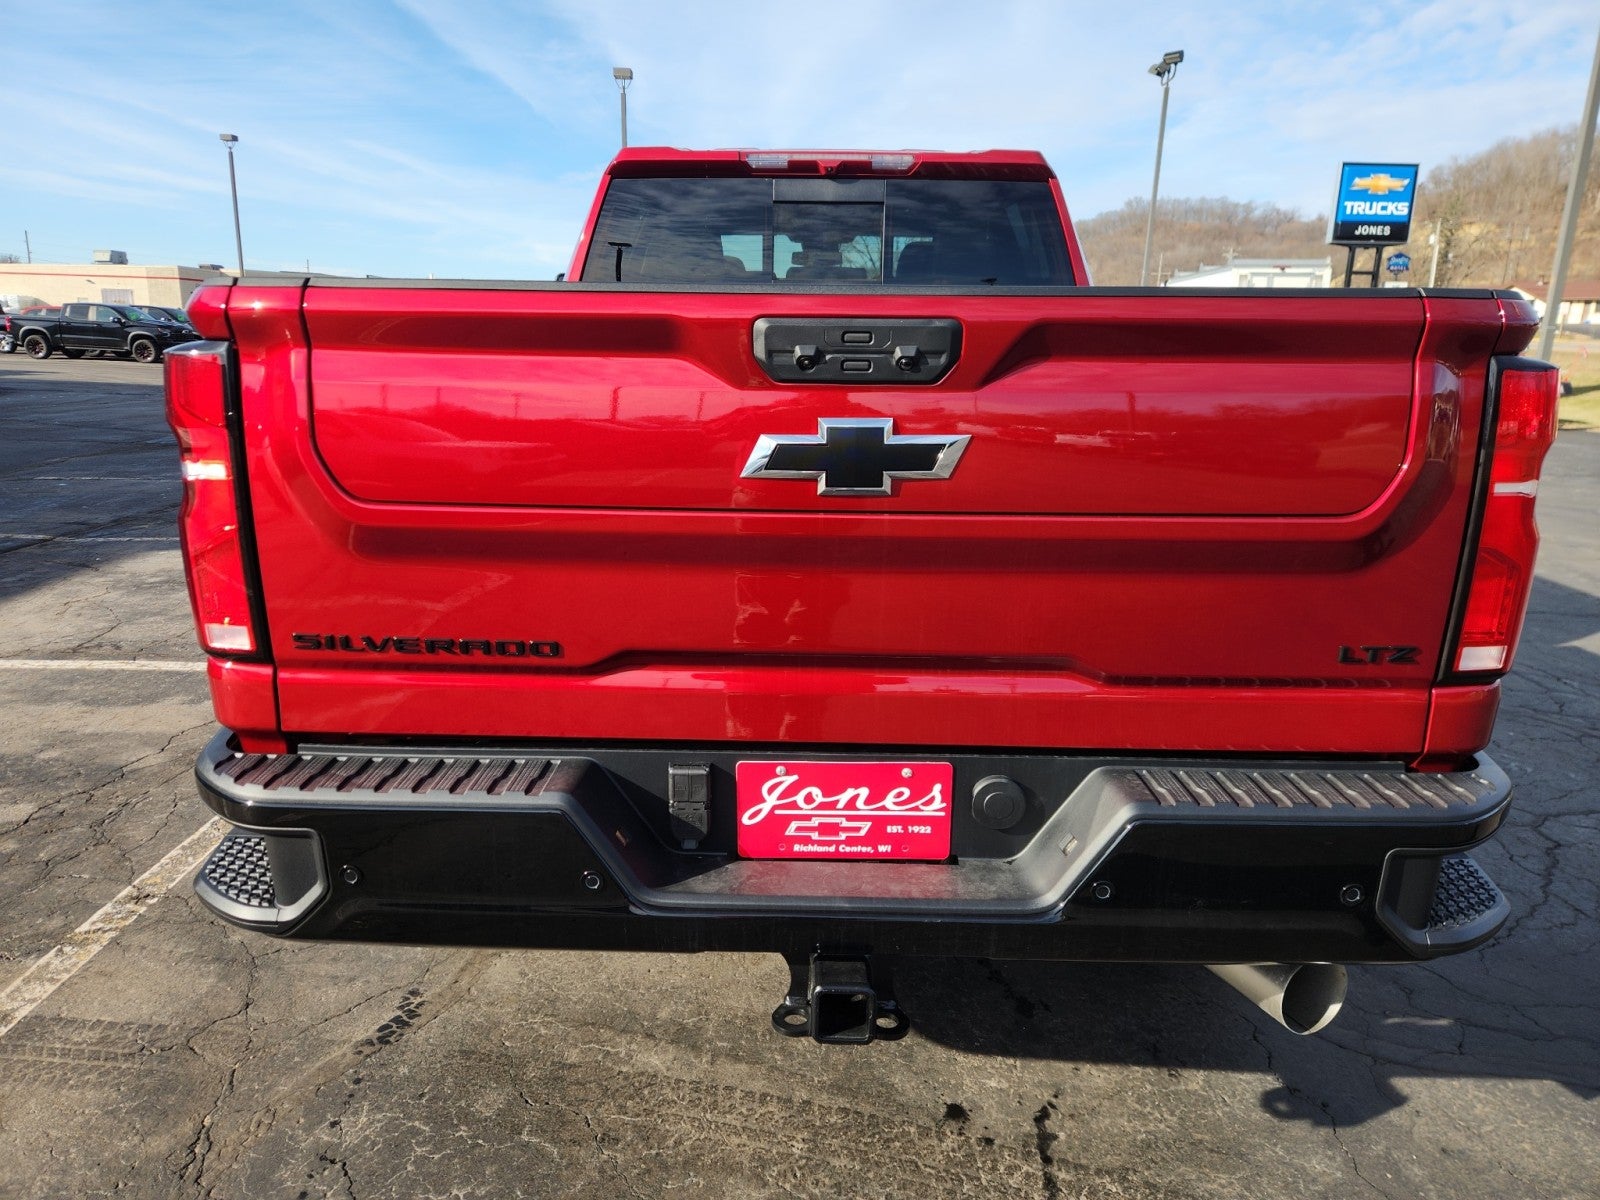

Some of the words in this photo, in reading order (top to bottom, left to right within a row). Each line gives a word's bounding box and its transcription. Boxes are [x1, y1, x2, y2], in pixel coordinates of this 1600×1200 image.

[1344, 201, 1409, 216] TRUCKS
[1354, 224, 1391, 236] JONES
[292, 632, 562, 659] SILVERADO
[1338, 645, 1420, 664] LTZ
[741, 774, 947, 826] Jones
[886, 825, 904, 834] EST.
[907, 825, 932, 834] 1922
[793, 843, 836, 853] Richland
[838, 844, 874, 854] Center,
[877, 844, 892, 853] WI
